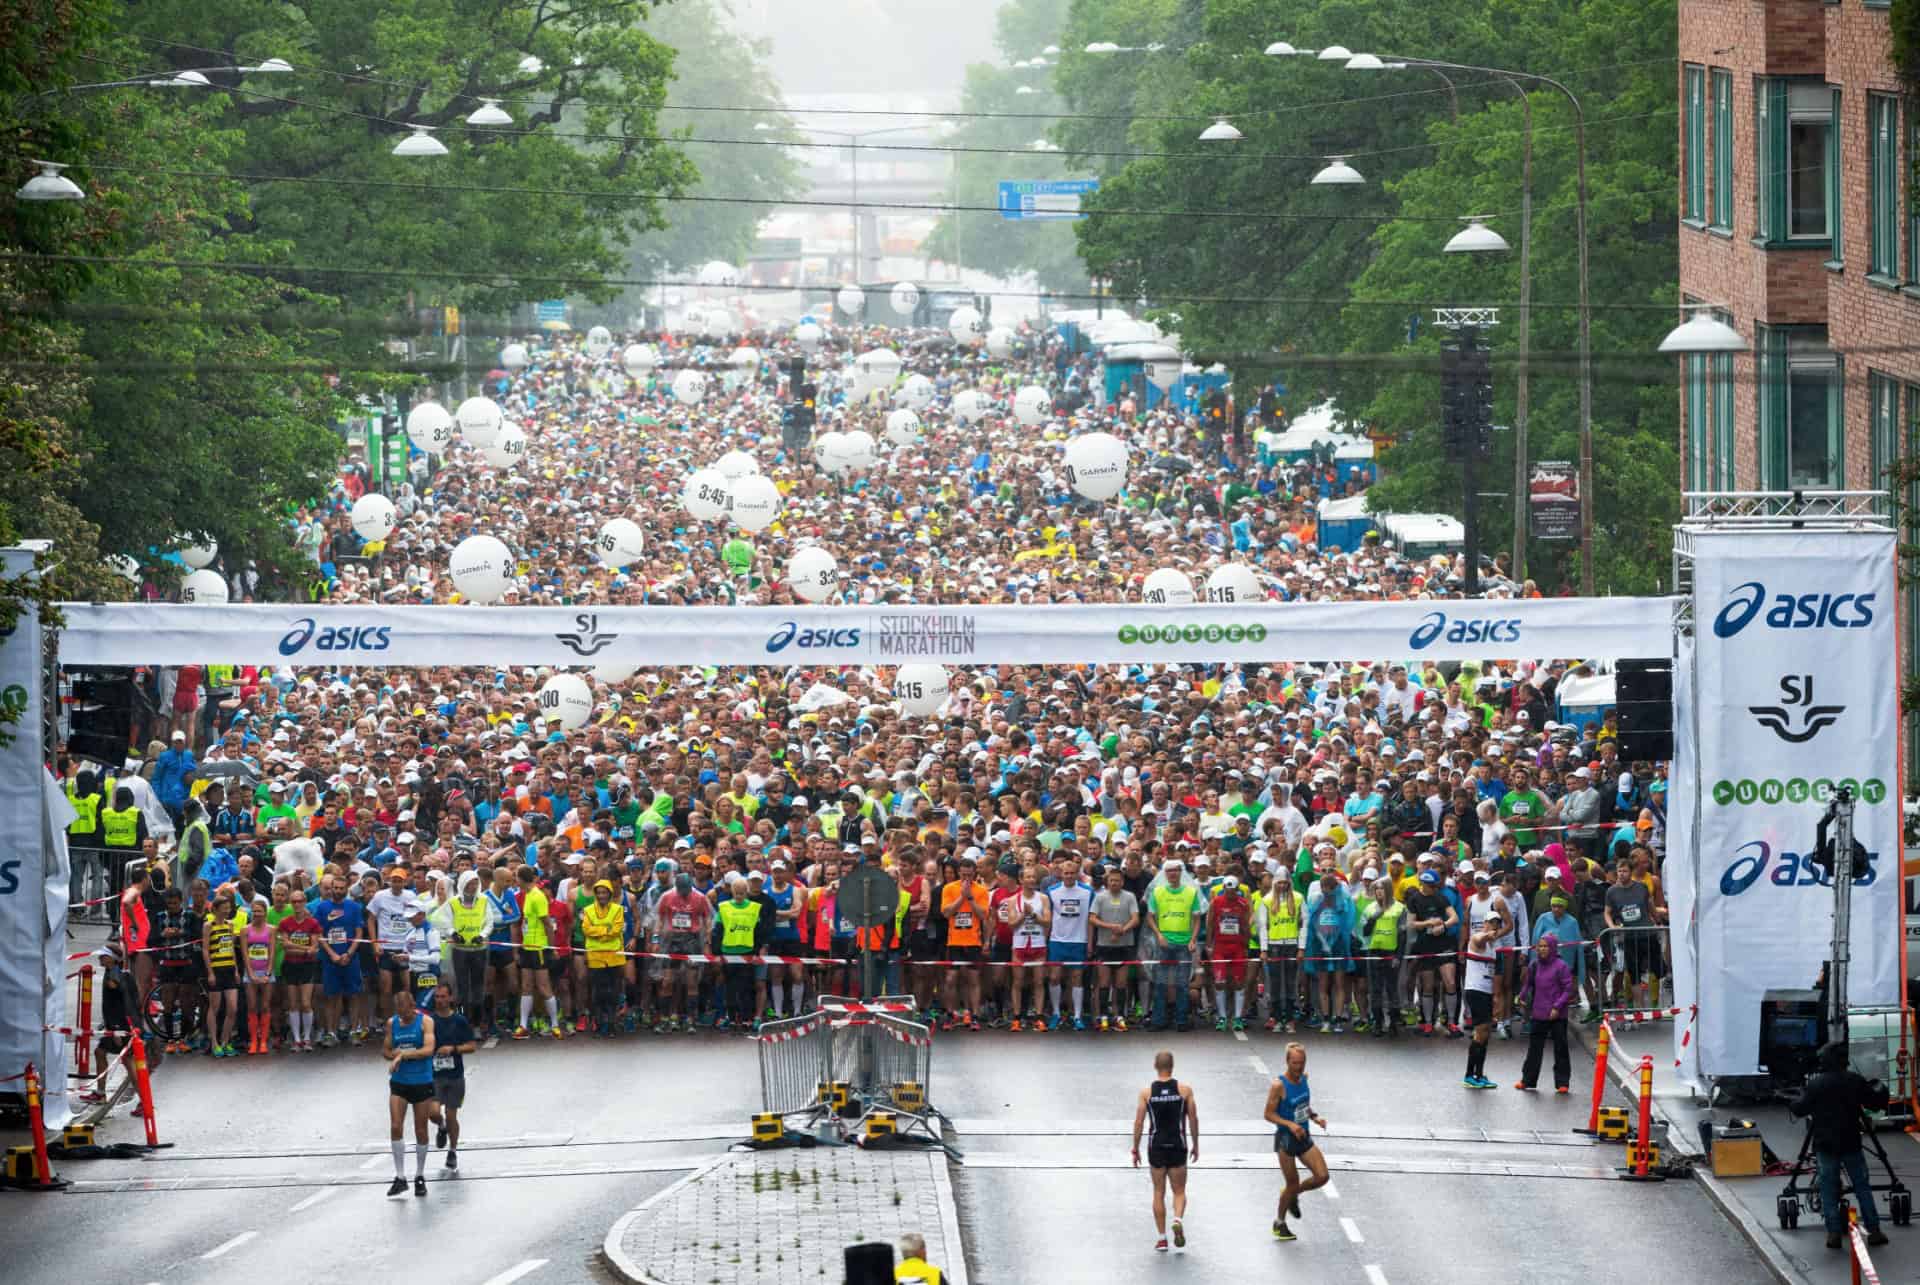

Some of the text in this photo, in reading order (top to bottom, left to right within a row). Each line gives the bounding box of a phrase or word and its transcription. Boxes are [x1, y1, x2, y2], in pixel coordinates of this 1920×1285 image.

[698, 483, 727, 505] 3:45
[575, 614, 598, 634] SJ
[879, 615, 976, 635] STOCKHOLM
[1141, 625, 1265, 643] UNIBET
[879, 635, 976, 655] MARATHON
[1779, 675, 1814, 706] SJ
[1771, 851, 1880, 887] ass
